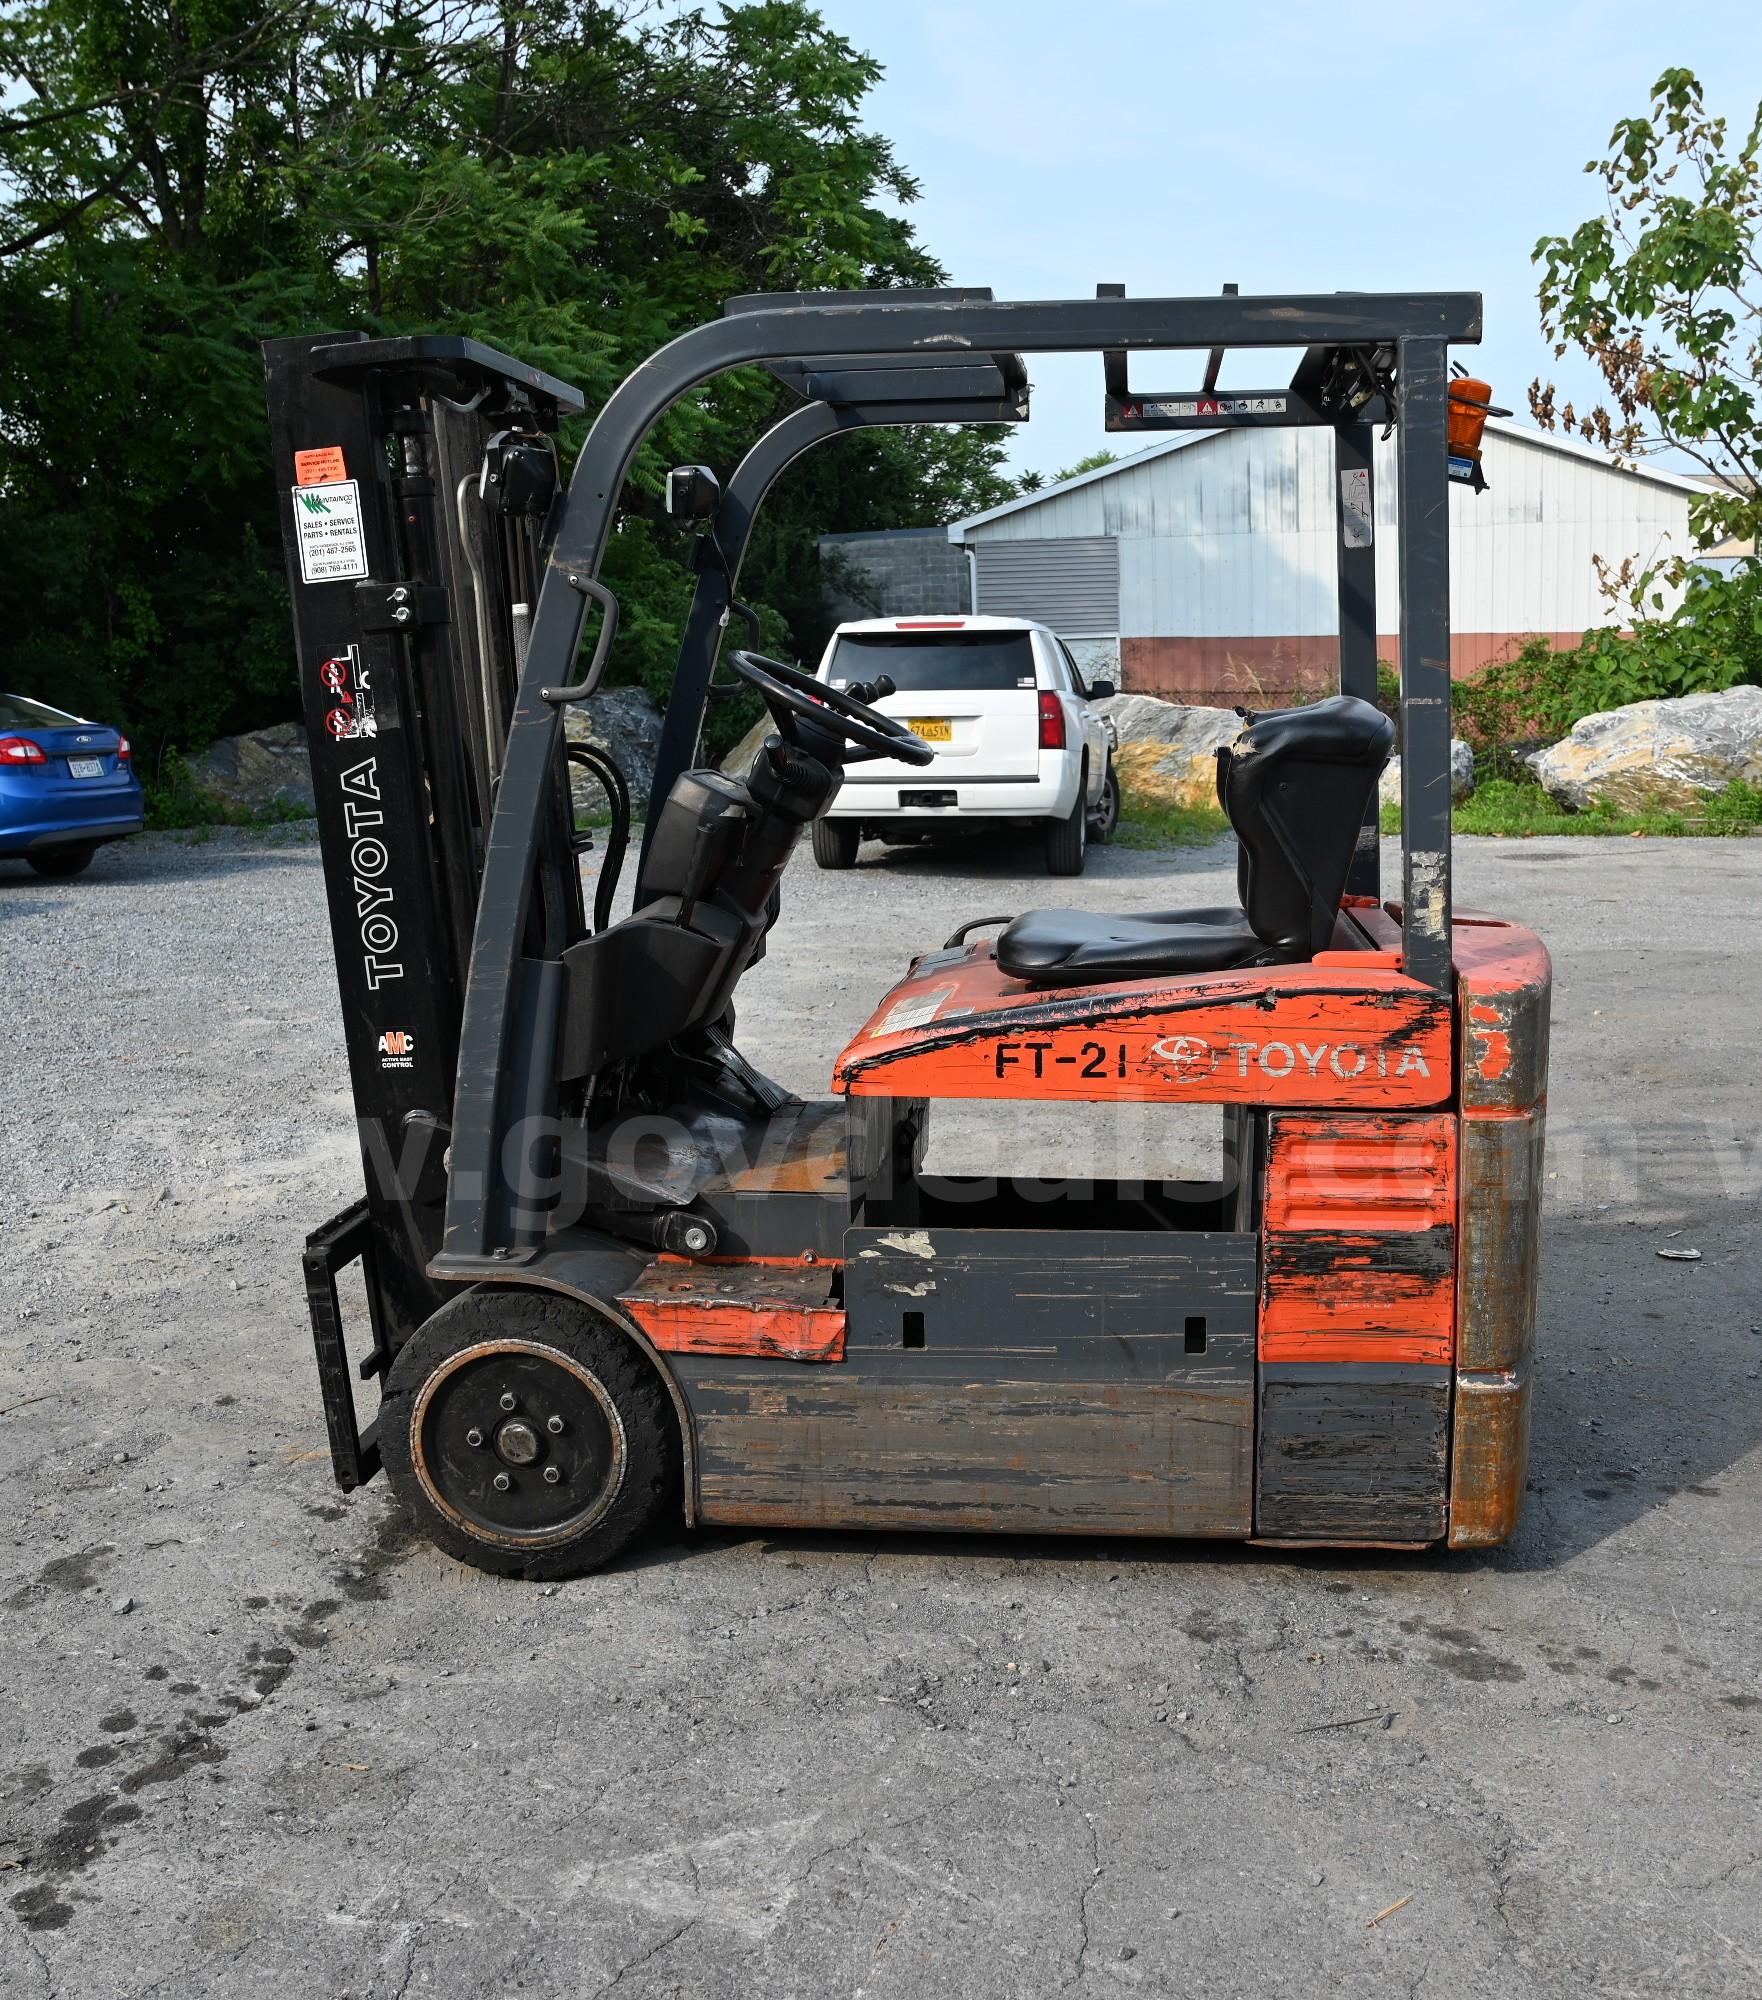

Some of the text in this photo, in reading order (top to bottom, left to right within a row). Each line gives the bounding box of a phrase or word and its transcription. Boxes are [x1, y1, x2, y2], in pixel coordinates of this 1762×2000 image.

[303, 517, 355, 529] SALES SERVICE
[303, 527, 357, 539] PARTS RENTALS
[341, 756, 404, 991] TOYOTA
[378, 1031, 414, 1055] AMC
[996, 1041, 1432, 1079] FT-21 TOYOTA
